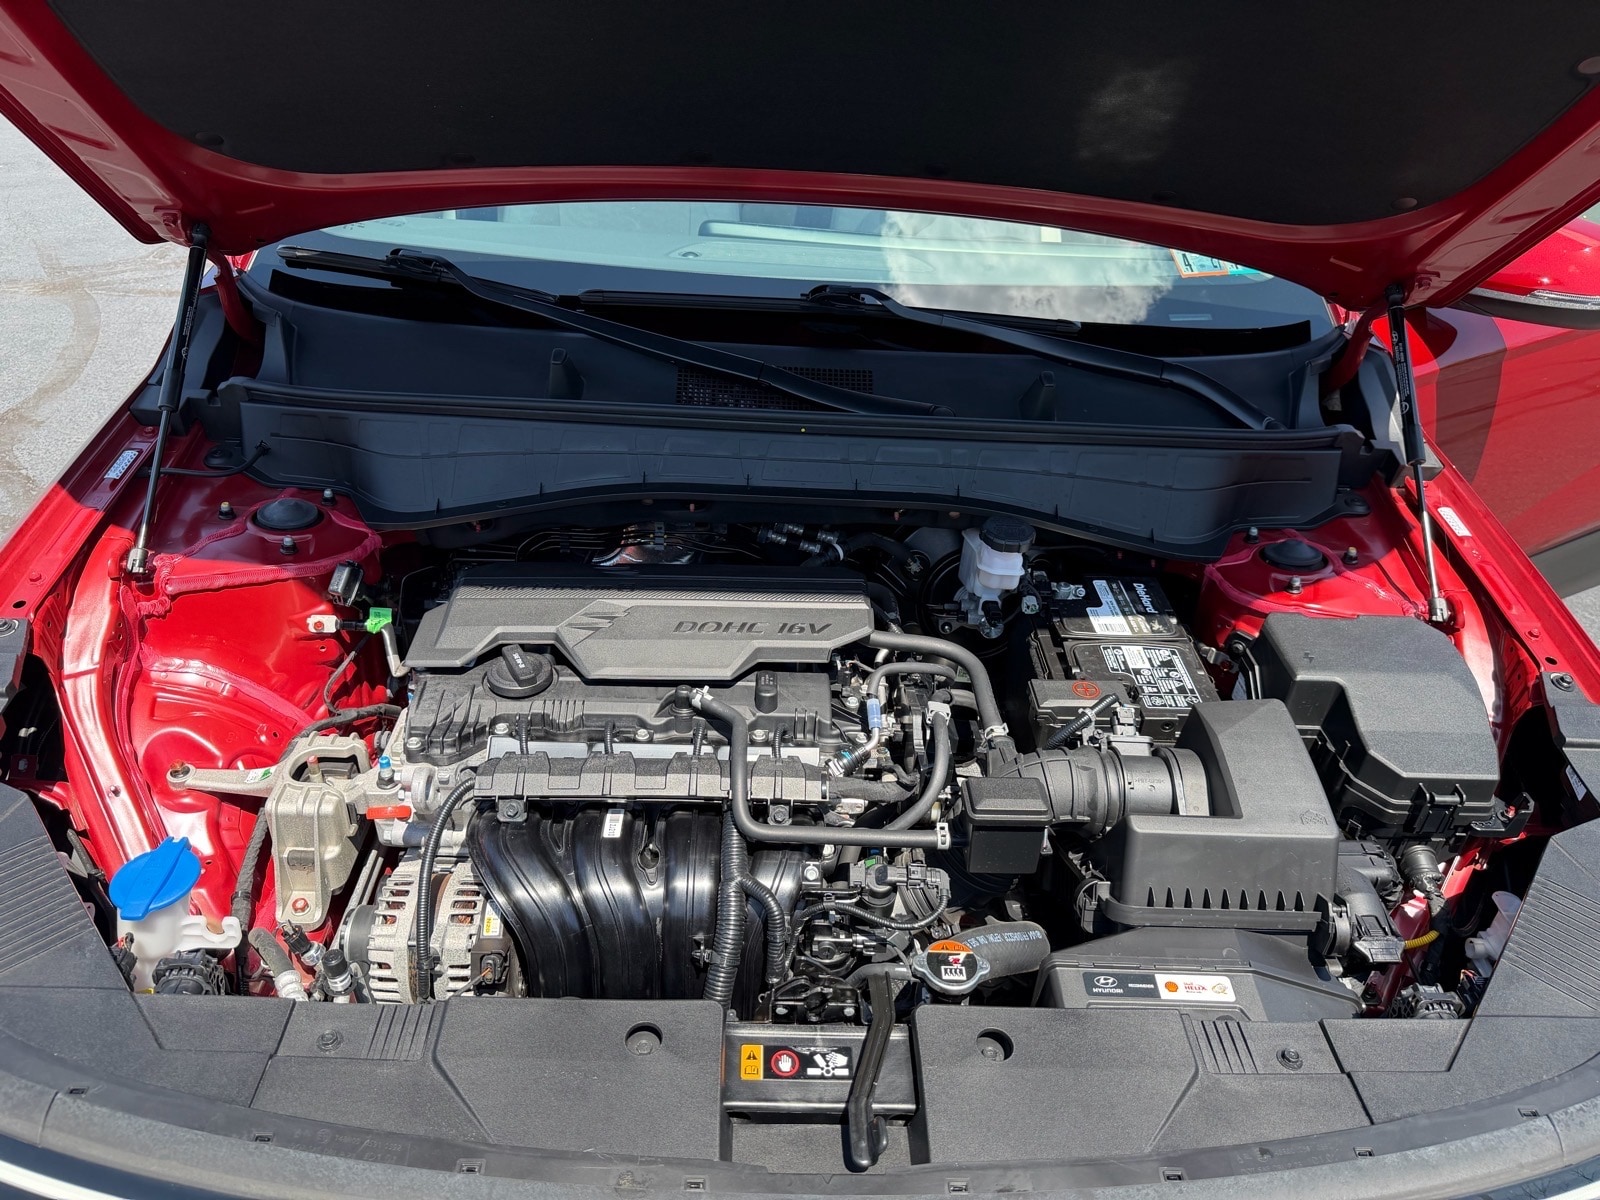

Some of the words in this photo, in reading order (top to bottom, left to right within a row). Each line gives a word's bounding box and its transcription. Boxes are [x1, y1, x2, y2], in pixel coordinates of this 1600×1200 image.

[1133, 583, 1159, 614] DieHard
[672, 621, 769, 635] DOHC
[777, 622, 832, 635] 16V
